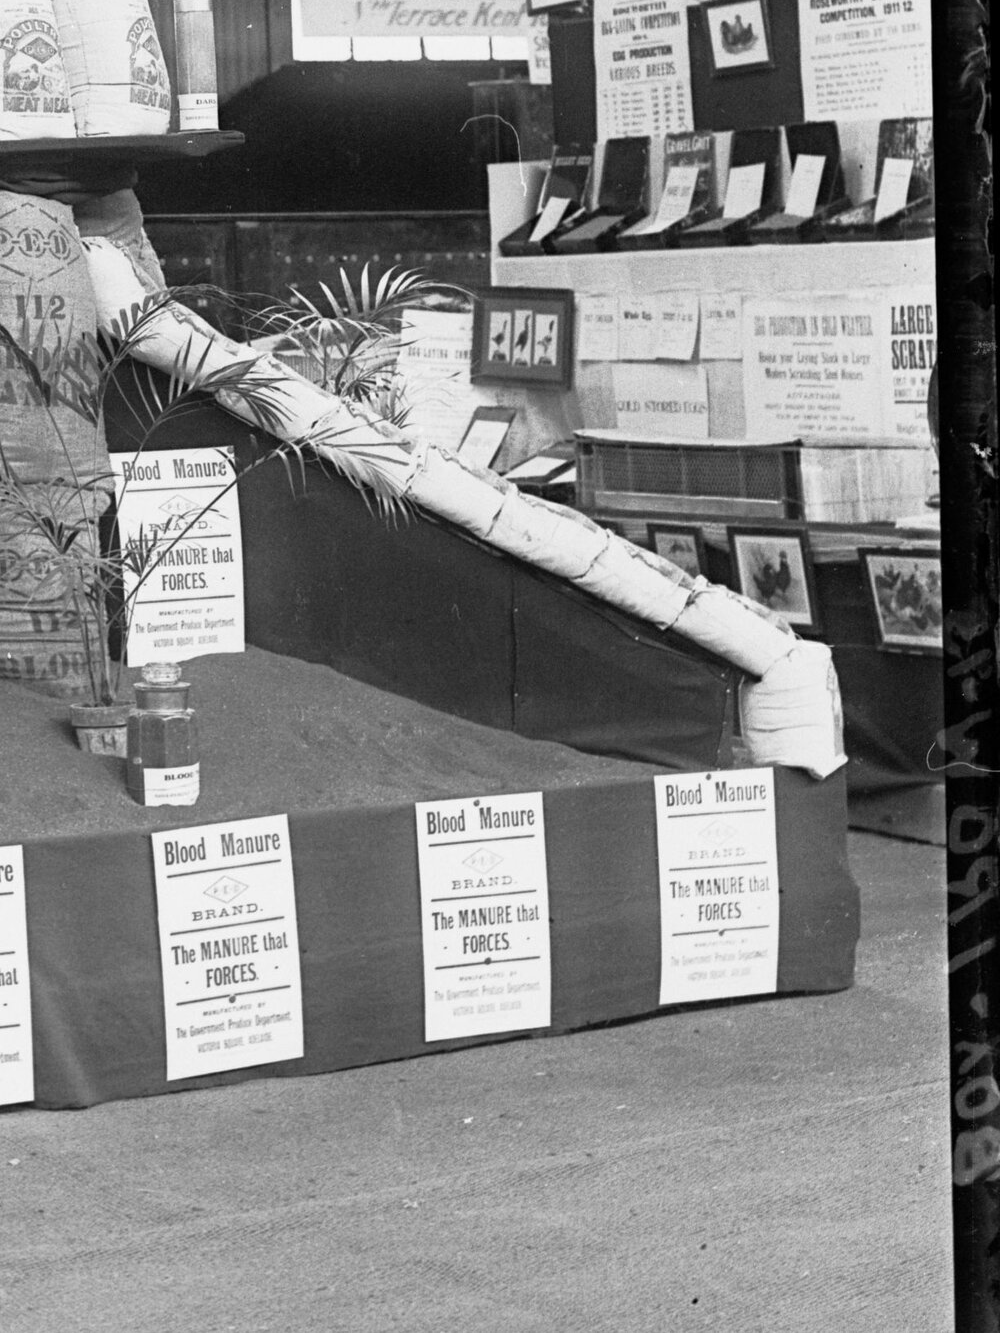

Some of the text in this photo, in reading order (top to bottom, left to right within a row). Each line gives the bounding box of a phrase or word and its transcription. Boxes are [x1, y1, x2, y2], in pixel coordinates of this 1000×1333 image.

[3, 96, 42, 113] MEAT
[15, 294, 66, 320] 112
[891, 304, 934, 335] LARGE
[121, 458, 227, 482] Blood Manure
[157, 547, 234, 568] MANURE that
[162, 572, 209, 591] FORCES.
[147, 622, 178, 634] Government
[666, 781, 767, 807] Blood Manure
[426, 807, 535, 835] Blood Manure
[164, 832, 281, 866] Blood Manure
[670, 875, 770, 899] The MANURE that
[192, 903, 264, 921] BRAND.
[432, 904, 540, 931] The MANURE that
[171, 932, 288, 966] The MANURE that
[206, 962, 259, 988] FORCES.
